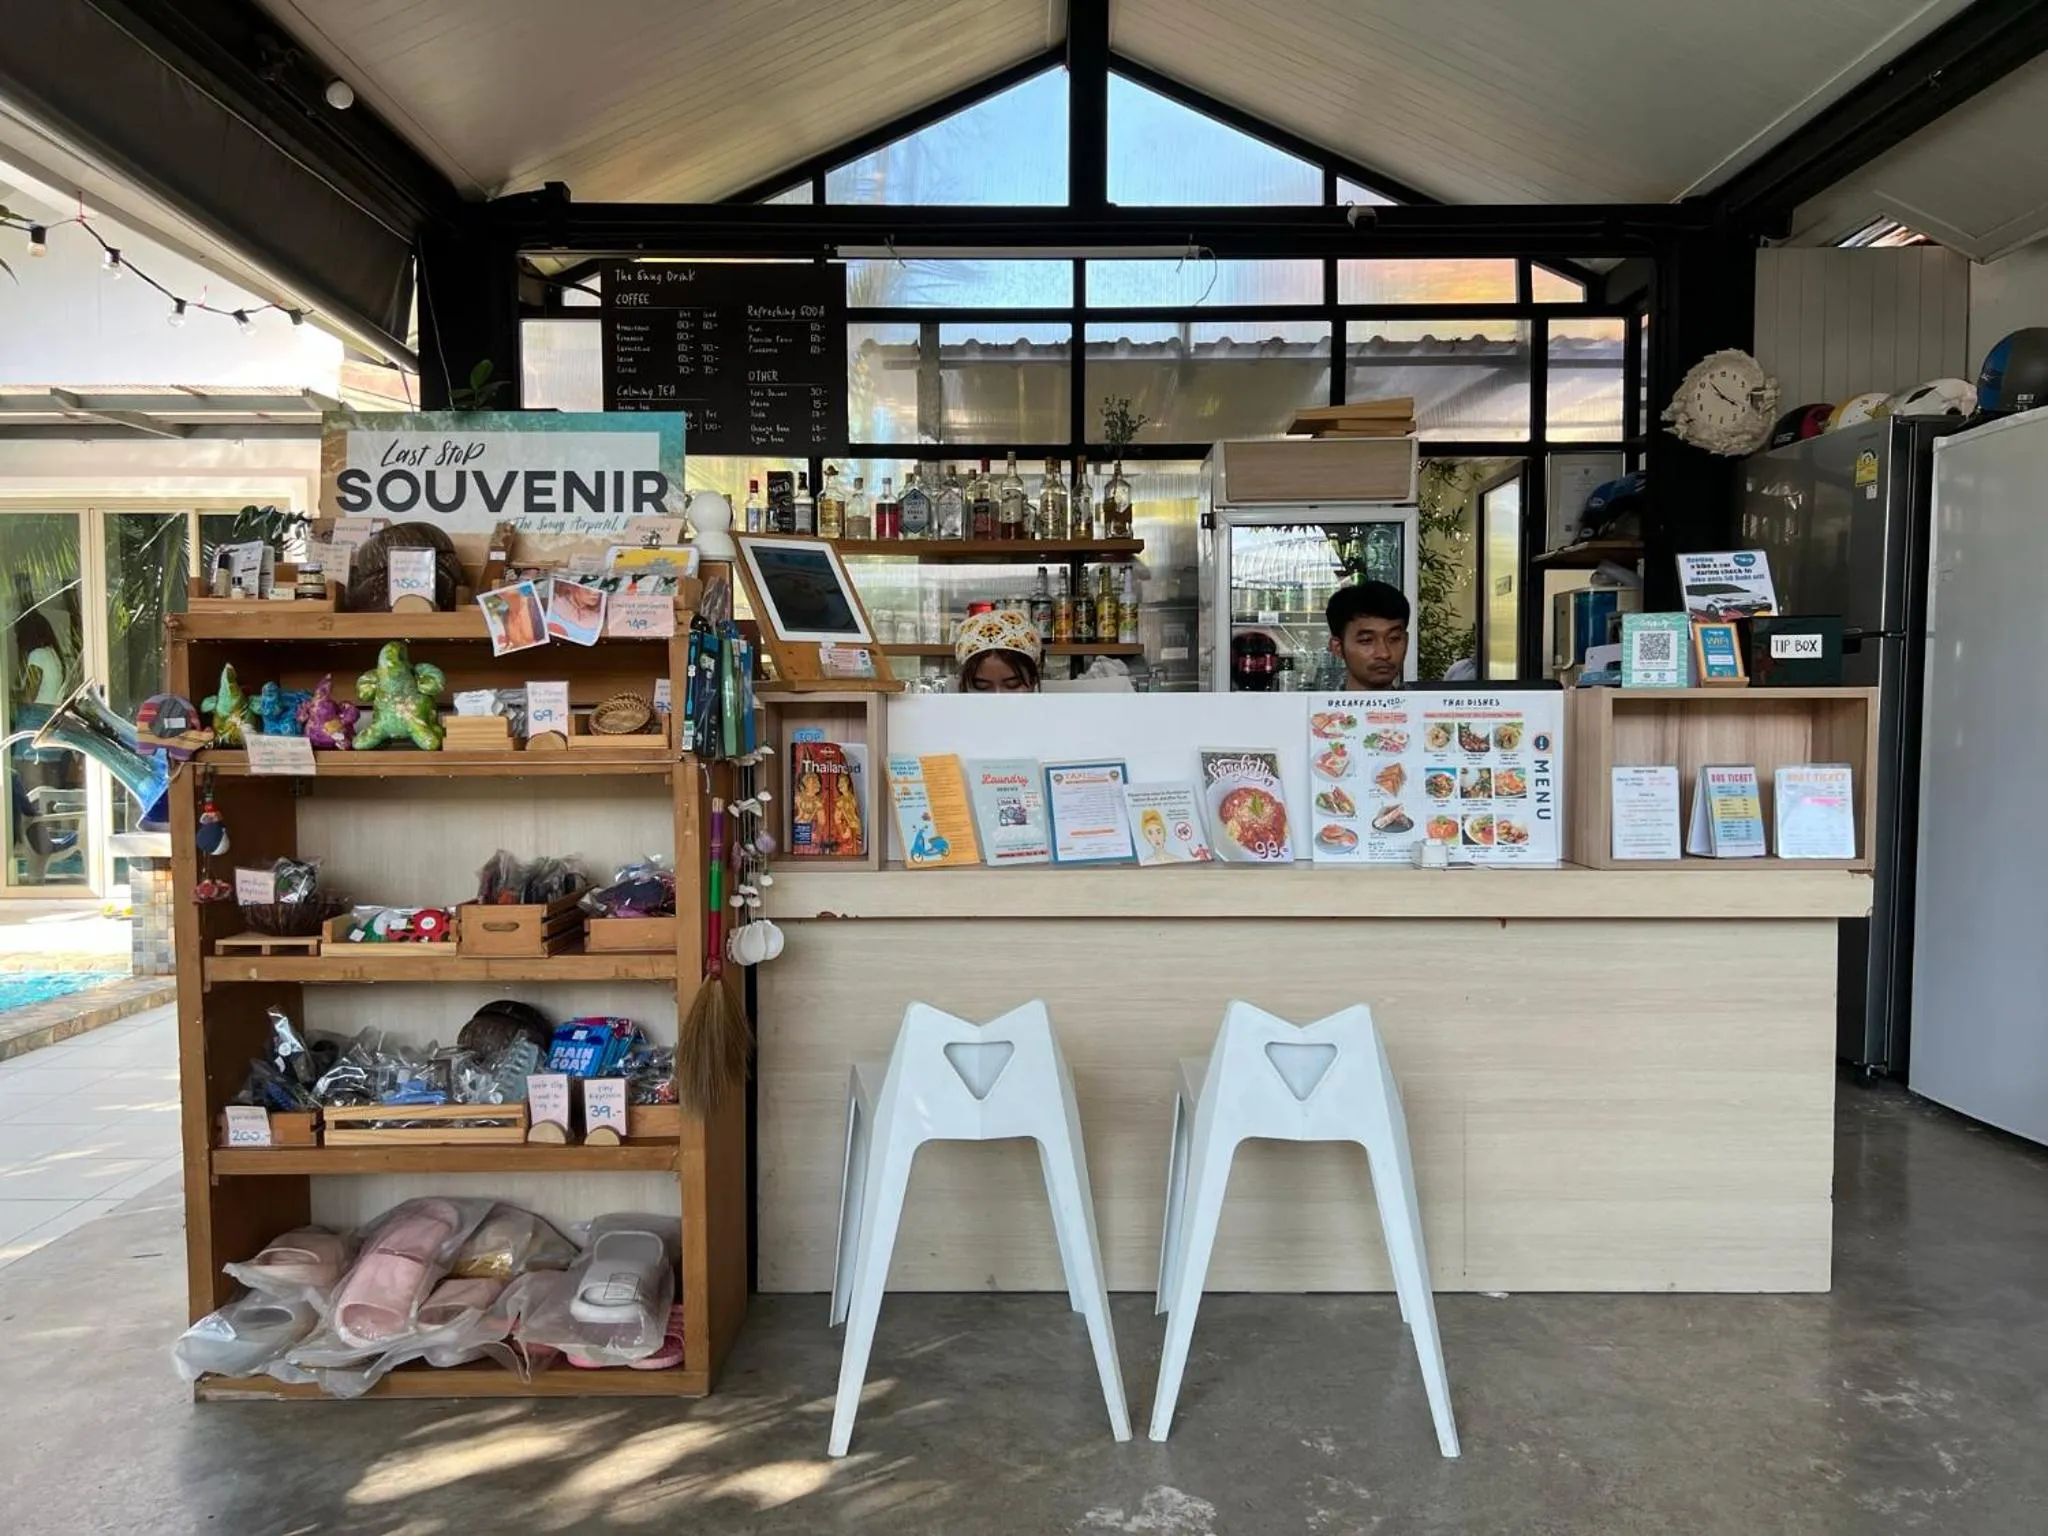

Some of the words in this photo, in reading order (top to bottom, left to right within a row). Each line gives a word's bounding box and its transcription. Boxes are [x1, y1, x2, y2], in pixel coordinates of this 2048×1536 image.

[615, 293, 650, 306] COFFEE
[380, 438, 429, 467] Last
[335, 468, 669, 514] SOUVENIR
[1773, 639, 1791, 654] TIP
[1794, 639, 1818, 653] BOX
[1467, 698, 1500, 707] DISHES
[982, 773, 1029, 788] Laundry
[1727, 773, 1753, 783] TICKET
[1534, 759, 1552, 821] MENU
[553, 1046, 595, 1059] RAIN
[550, 1058, 591, 1071] COAT
